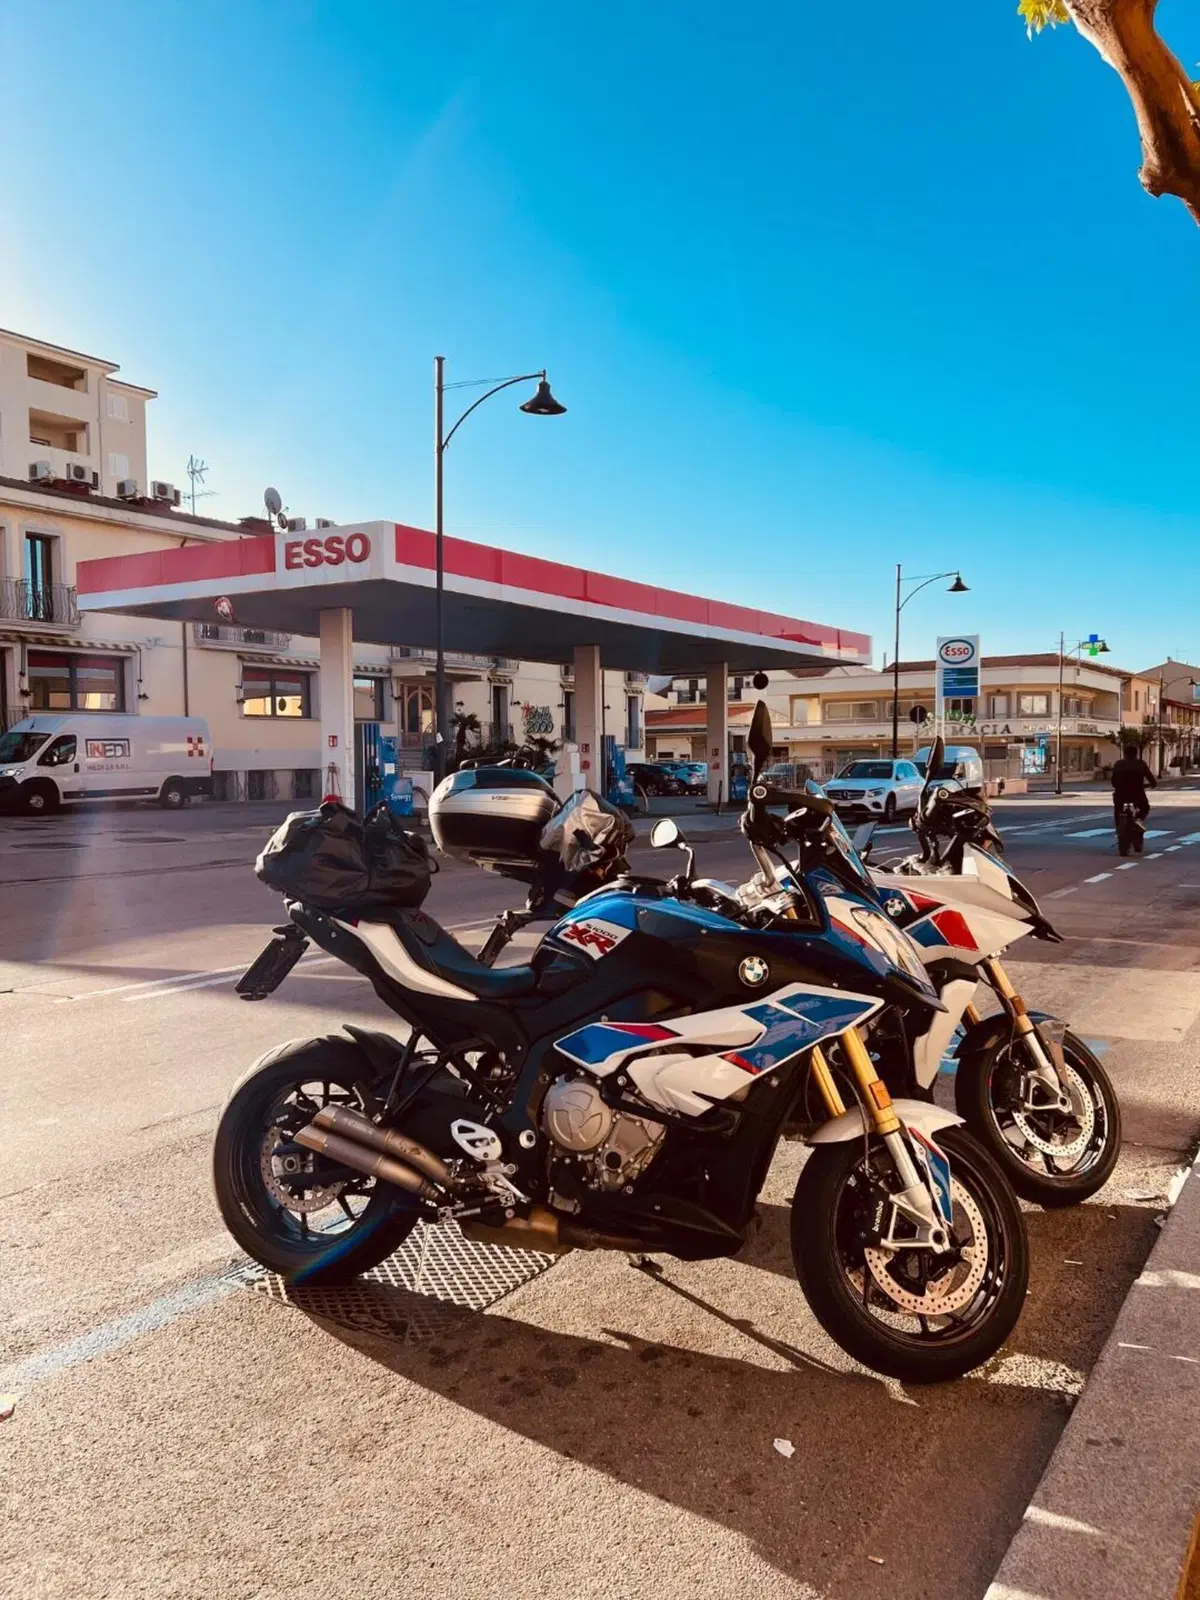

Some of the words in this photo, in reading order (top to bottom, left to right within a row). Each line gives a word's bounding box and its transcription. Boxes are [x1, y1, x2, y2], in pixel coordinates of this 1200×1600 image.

[283, 532, 371, 570] ESSO
[944, 645, 970, 656] Esso
[523, 720, 555, 735] 2000
[563, 922, 616, 955] XR
[871, 1200, 884, 1232] brembo
